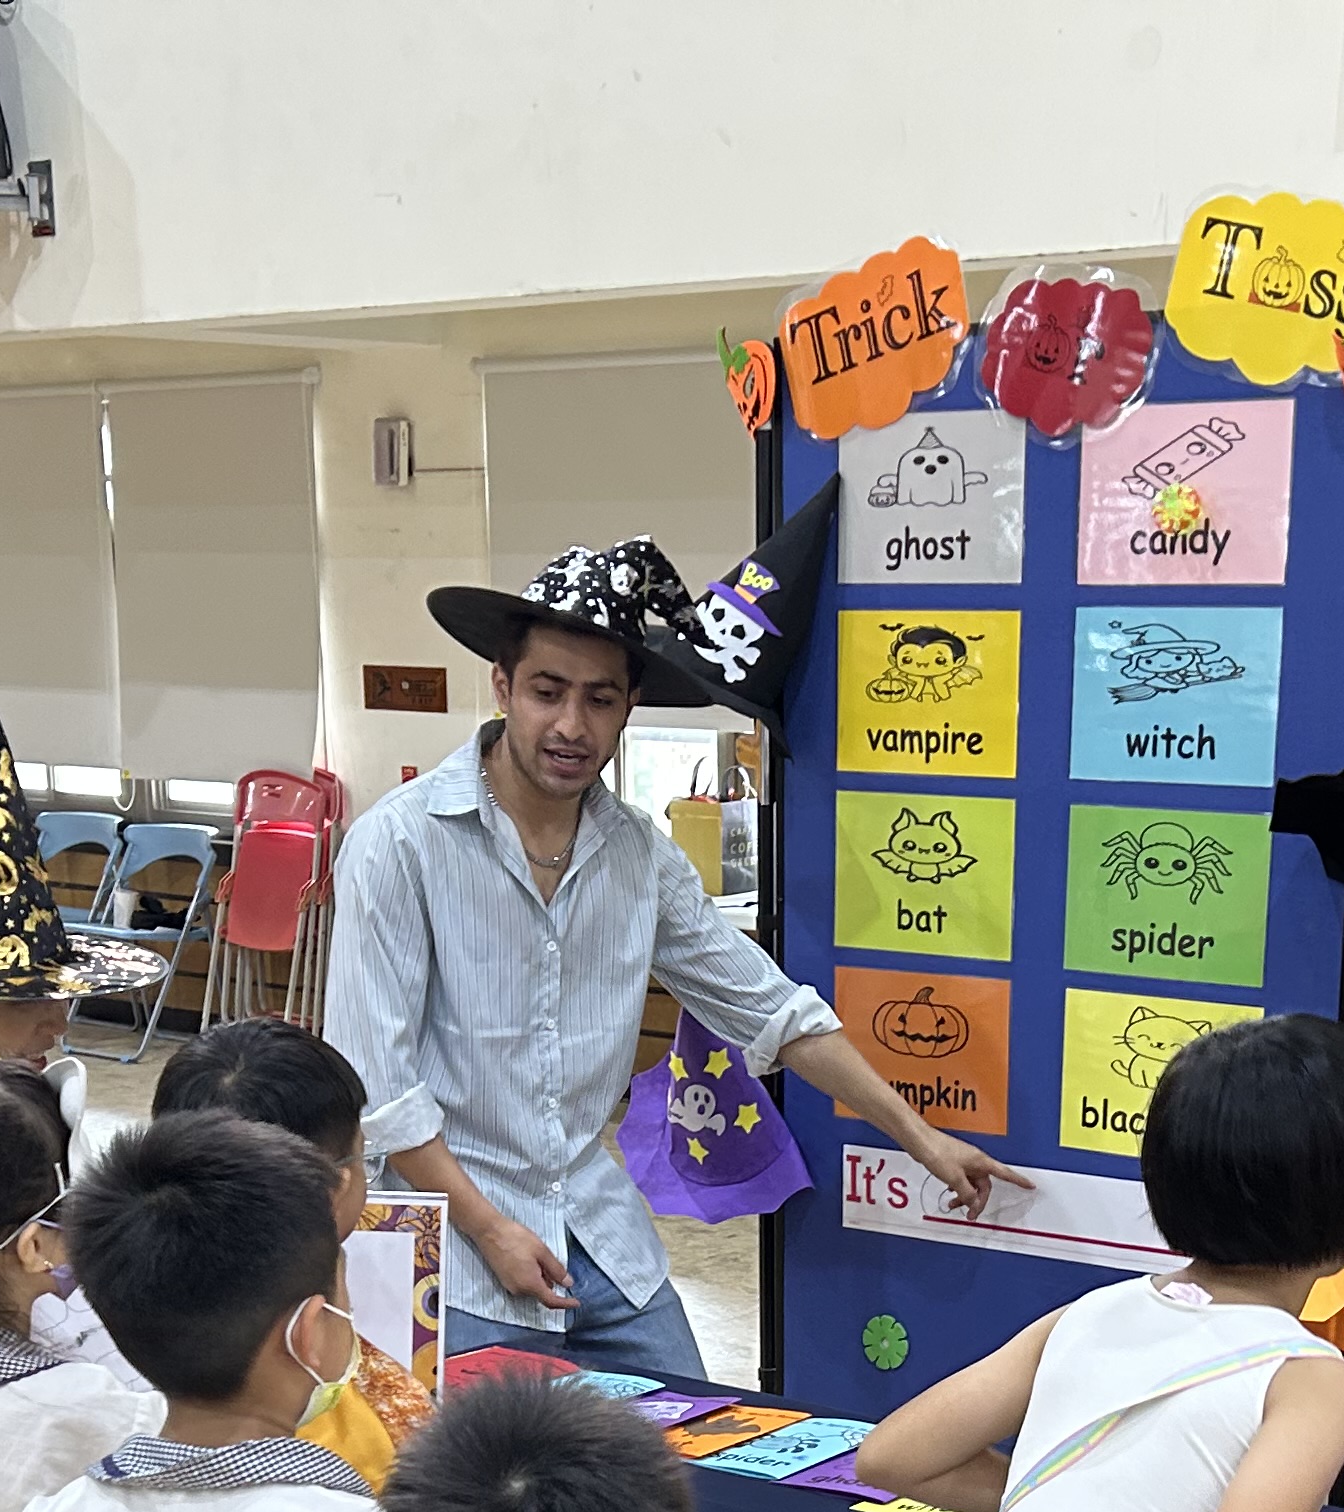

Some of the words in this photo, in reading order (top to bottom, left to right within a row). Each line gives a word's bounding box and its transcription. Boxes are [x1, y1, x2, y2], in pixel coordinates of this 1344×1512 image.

[790, 268, 956, 385] Trick
[885, 525, 971, 571] ghost
[1129, 518, 1231, 566] candy
[739, 562, 773, 590] Boo
[866, 723, 984, 763] vampire
[1125, 724, 1216, 760] witch
[896, 898, 948, 934] bat
[1111, 922, 1215, 962] spider
[893, 1076, 977, 1116] mpkin
[1081, 1096, 1145, 1135] blac
[846, 1154, 909, 1209] It's
